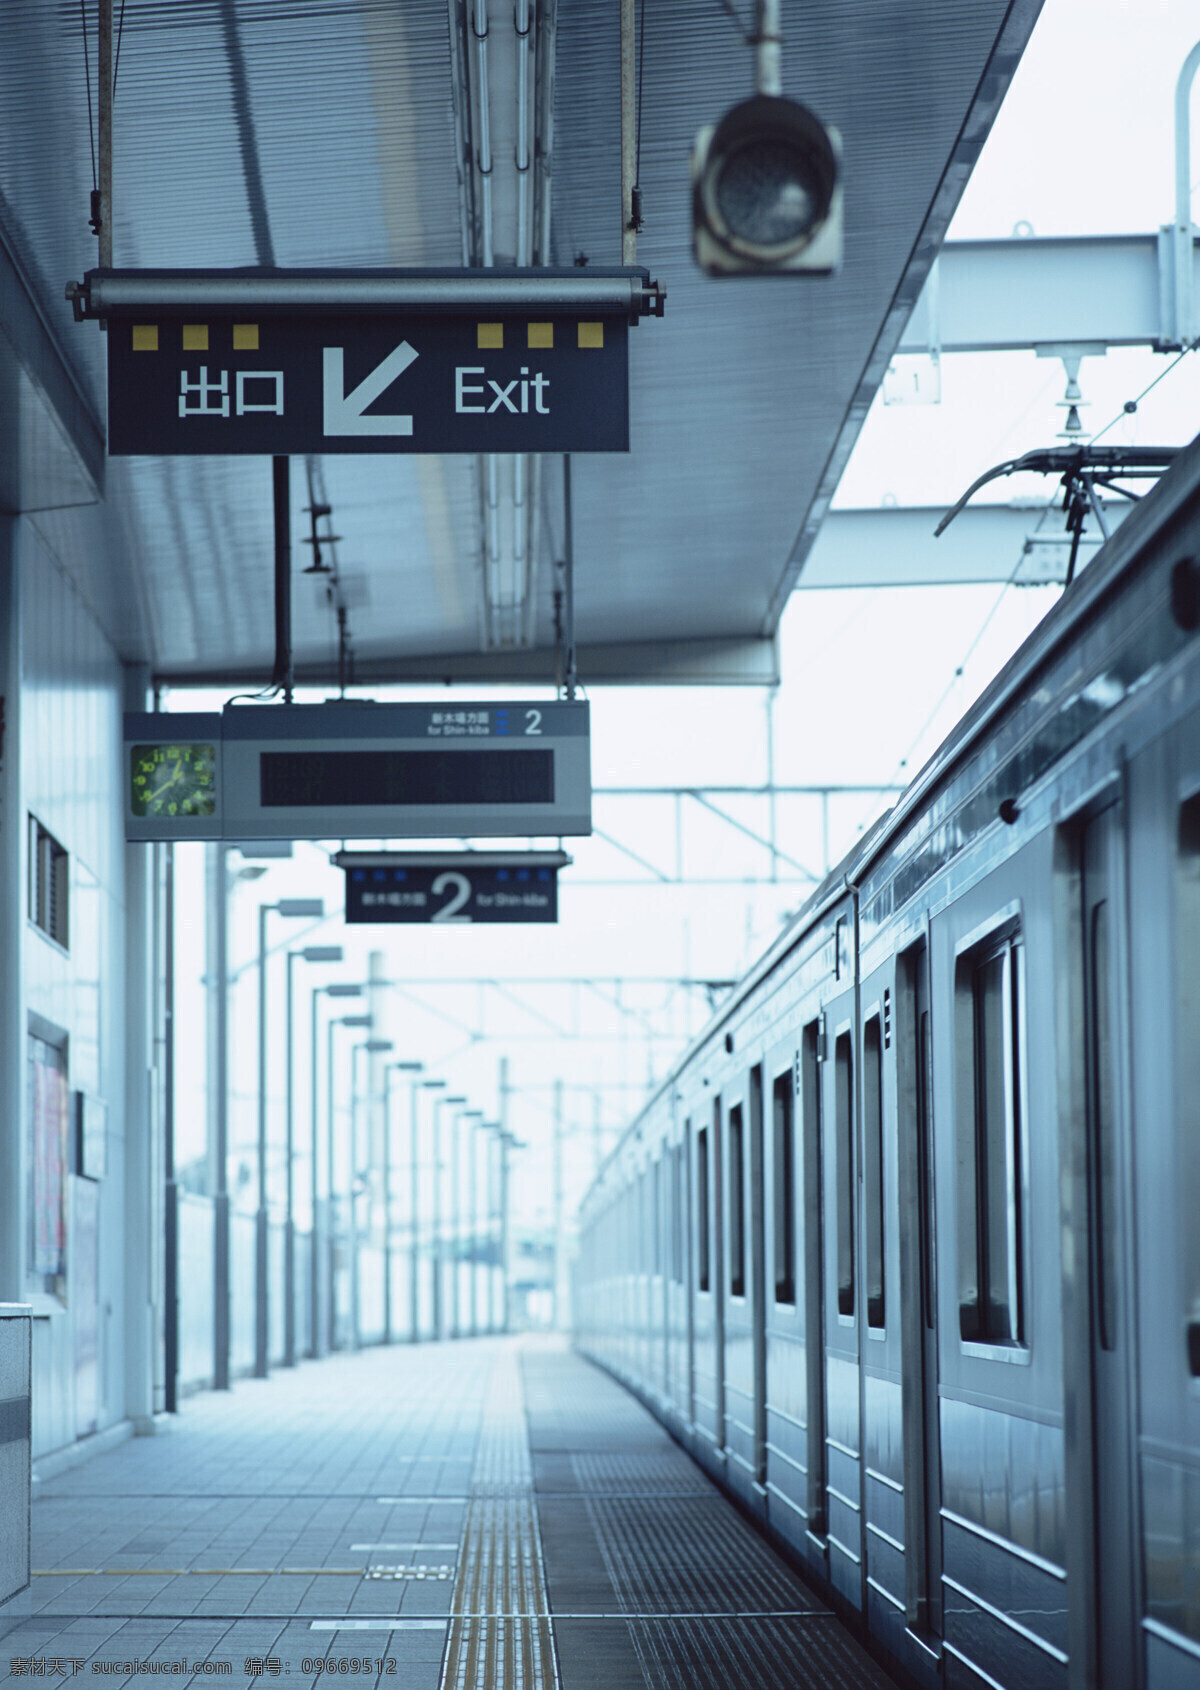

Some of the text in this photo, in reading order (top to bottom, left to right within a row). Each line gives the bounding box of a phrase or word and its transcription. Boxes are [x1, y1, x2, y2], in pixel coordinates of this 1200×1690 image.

[178, 366, 284, 417] 出口
[455, 366, 550, 414] Exit
[525, 709, 542, 735] 2
[430, 871, 473, 923] 2
